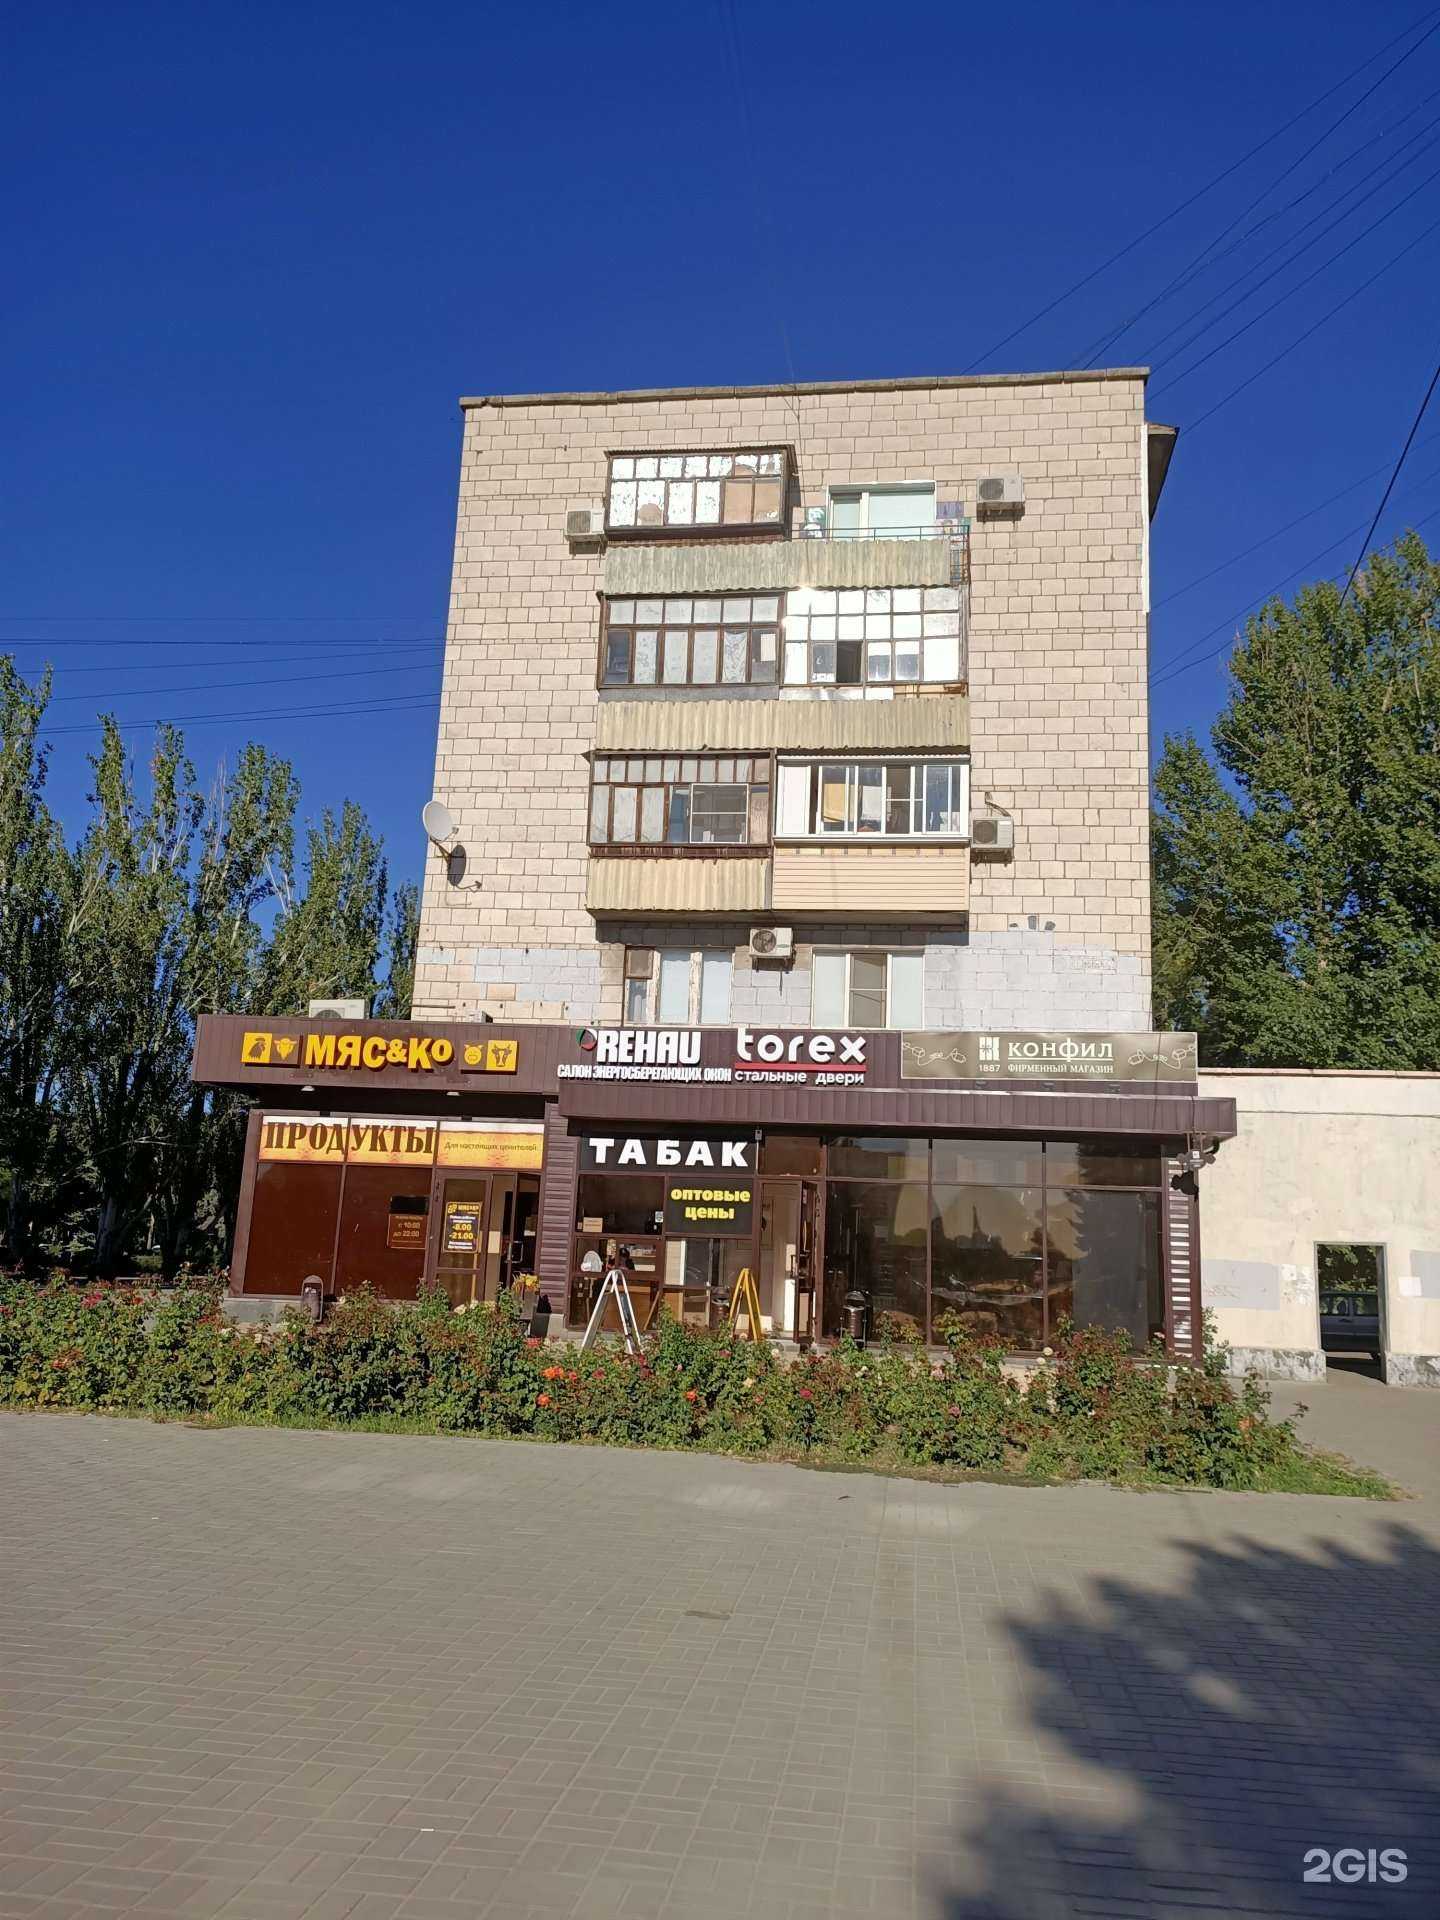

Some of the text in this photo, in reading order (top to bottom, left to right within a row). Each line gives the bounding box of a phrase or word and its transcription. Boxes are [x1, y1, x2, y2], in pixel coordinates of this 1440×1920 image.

[596, 1029, 702, 1064] REHAU
[735, 1026, 867, 1063] torex
[1008, 1038, 1114, 1063] КОНФИЛ
[557, 1064, 732, 1083] САЛОН ЭНЕРГОСБЕРЕГАЮЩИХ ОКОН
[734, 1070, 865, 1086] стальные двери
[979, 1064, 1001, 1073] 1887
[1007, 1063, 1114, 1074] ФИРМЕННЫЙ МАГАЗИН
[264, 1121, 435, 1154] ПРОДУКТЫ
[589, 1137, 749, 1168] ТАБАК
[670, 1188, 751, 1203] оптовые
[685, 1206, 735, 1221] цены
